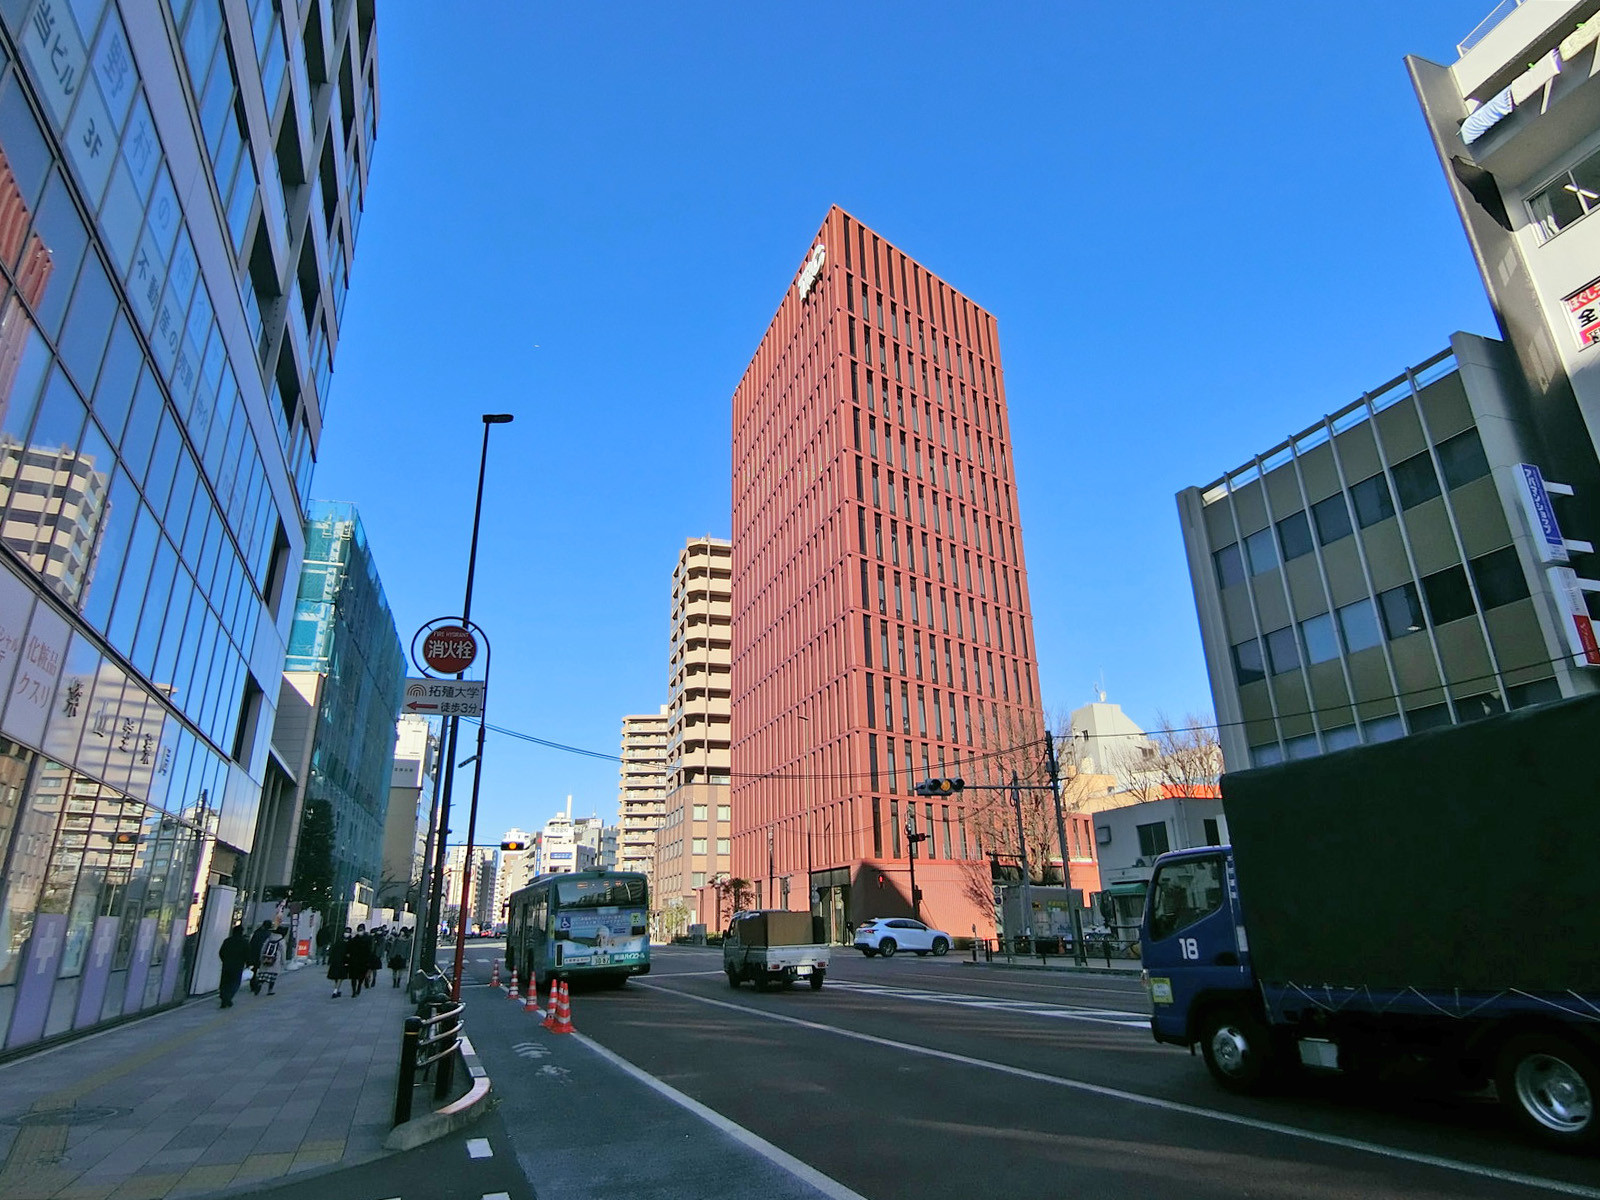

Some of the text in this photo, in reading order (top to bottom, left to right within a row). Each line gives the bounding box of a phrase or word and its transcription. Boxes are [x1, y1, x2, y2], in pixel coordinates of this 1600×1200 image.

[83, 117, 103, 159] 3F
[1523, 468, 1552, 534] アパマンショップ
[26, 634, 59, 676] 化粧品
[428, 640, 474, 659] 消火栓
[16, 672, 50, 709] クスリ
[428, 685, 480, 699] 拓殖大学
[440, 702, 478, 714] 徒歩3分
[1178, 938, 1199, 960] 18
